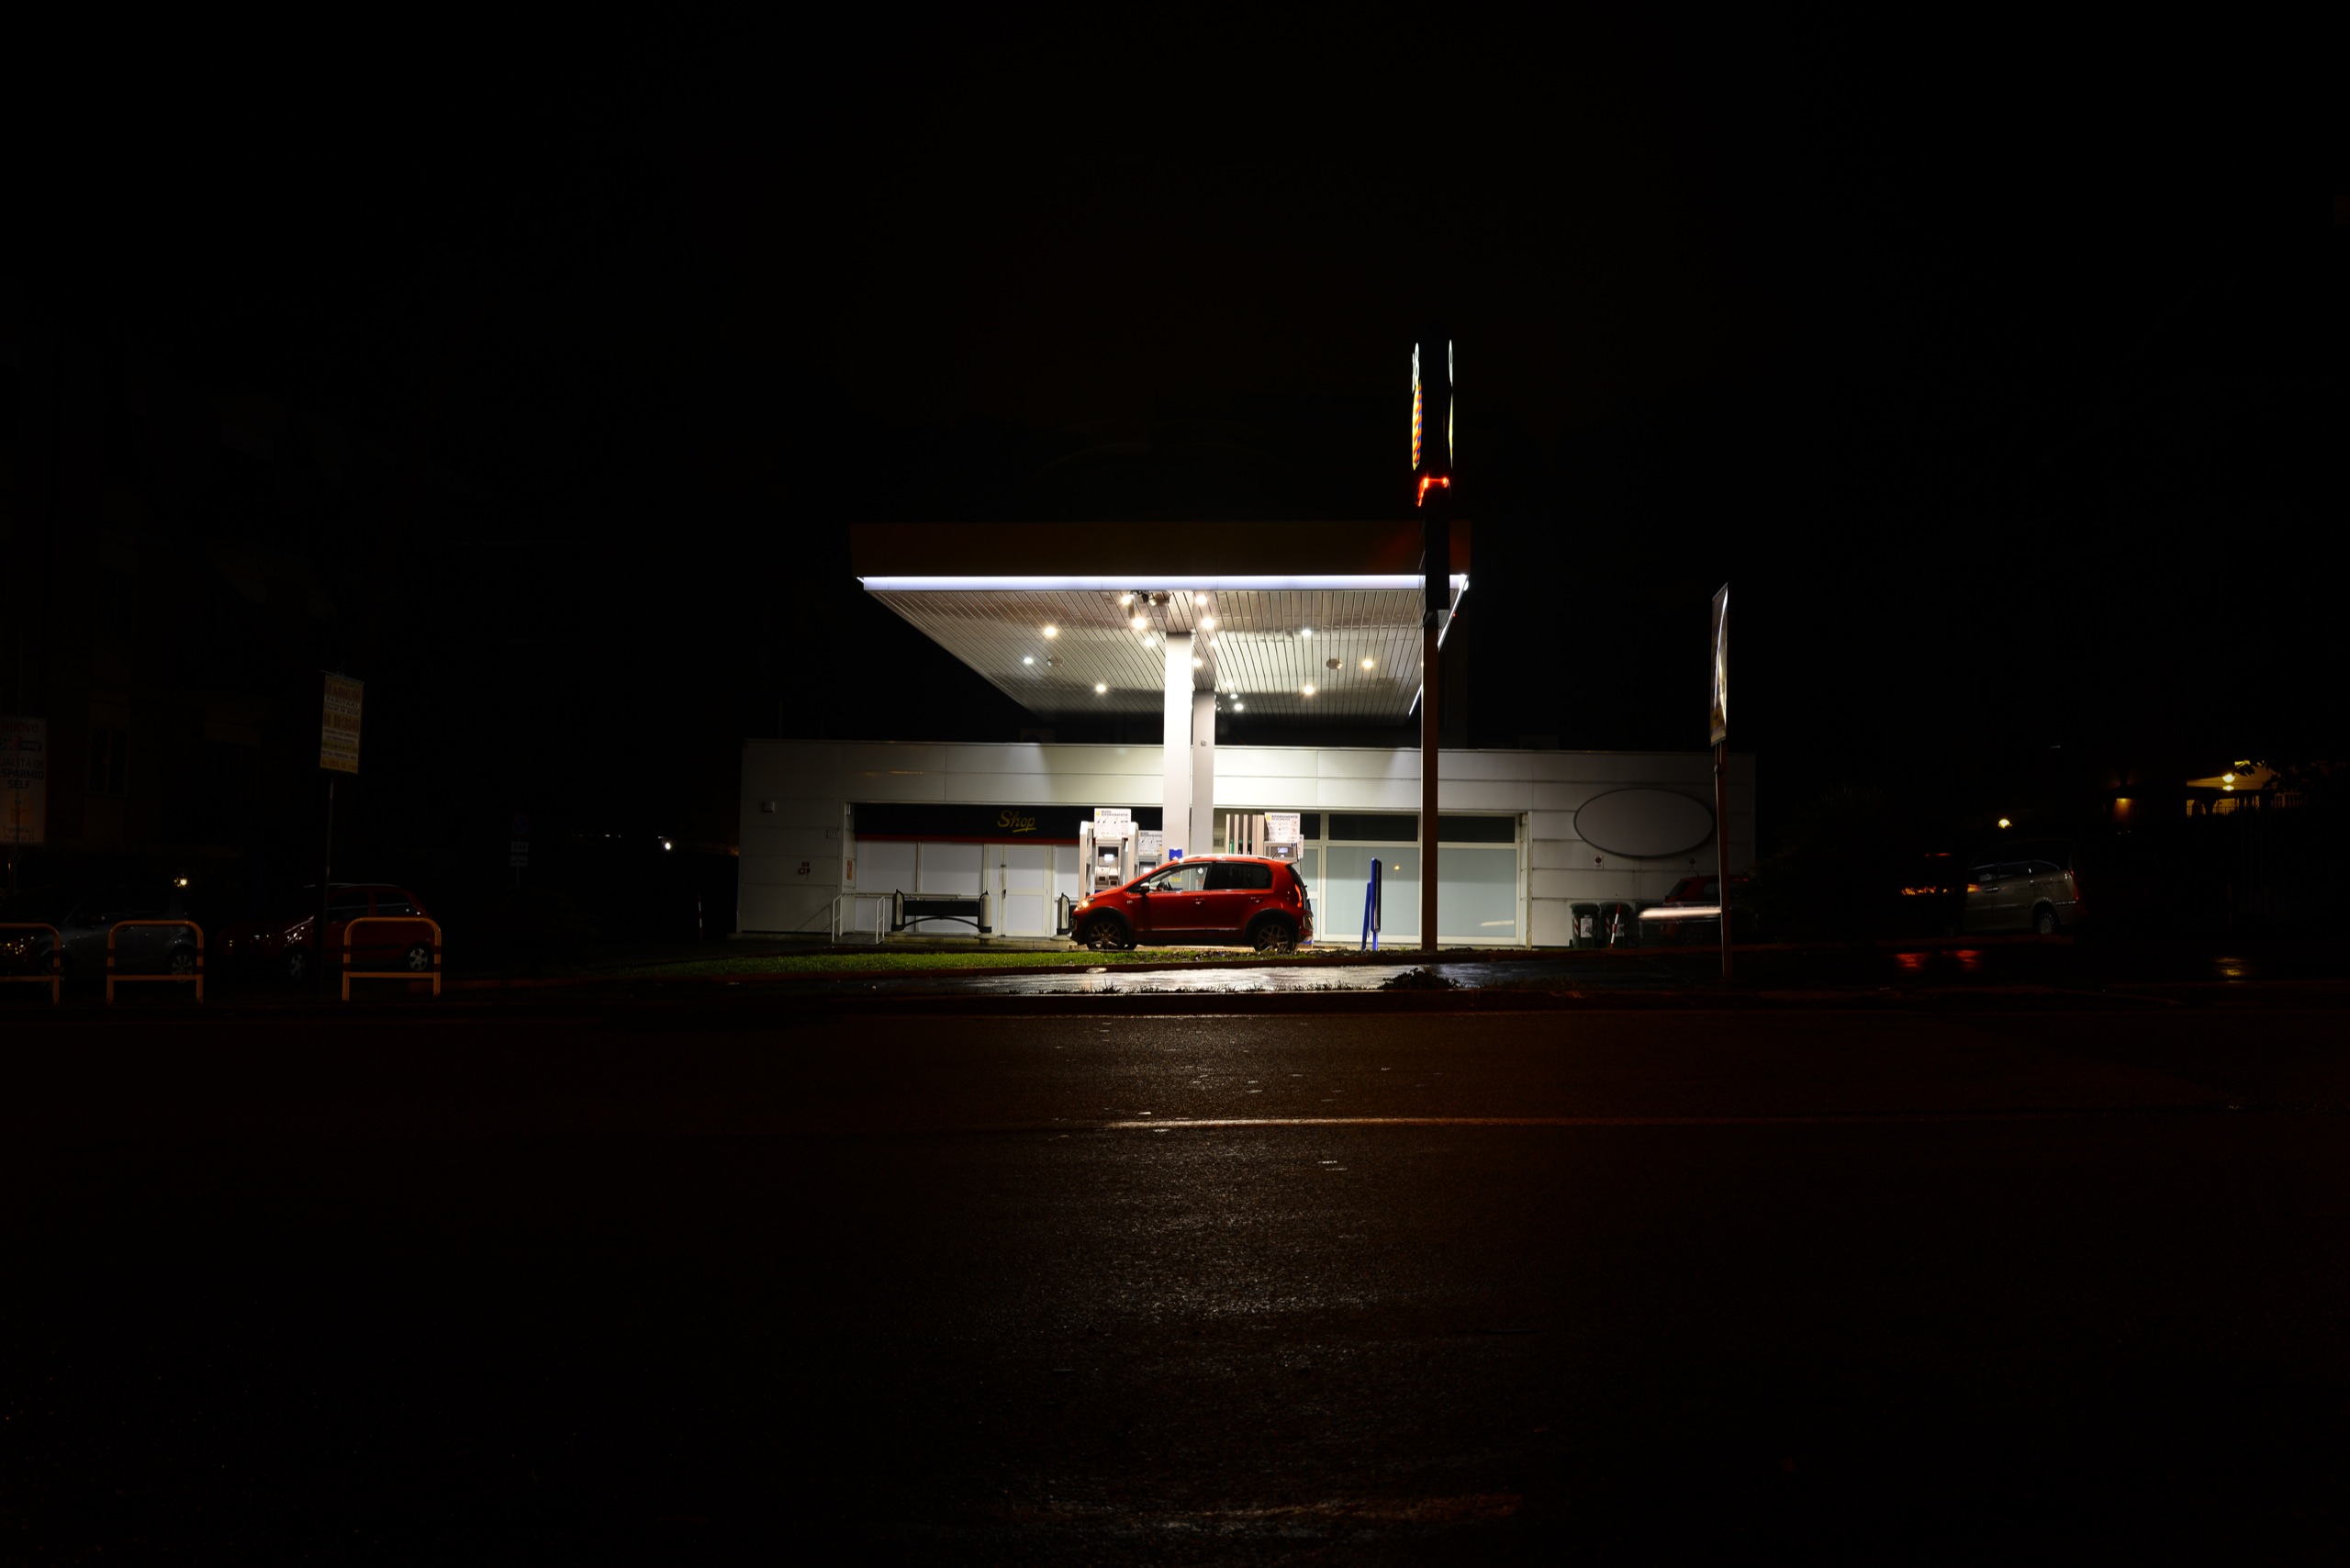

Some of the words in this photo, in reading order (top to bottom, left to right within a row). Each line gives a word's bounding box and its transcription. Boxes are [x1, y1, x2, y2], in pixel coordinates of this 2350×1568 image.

[2, 721, 39, 733] NUOVO
[7, 779, 31, 790] SELF
[997, 810, 1036, 833] Shop
